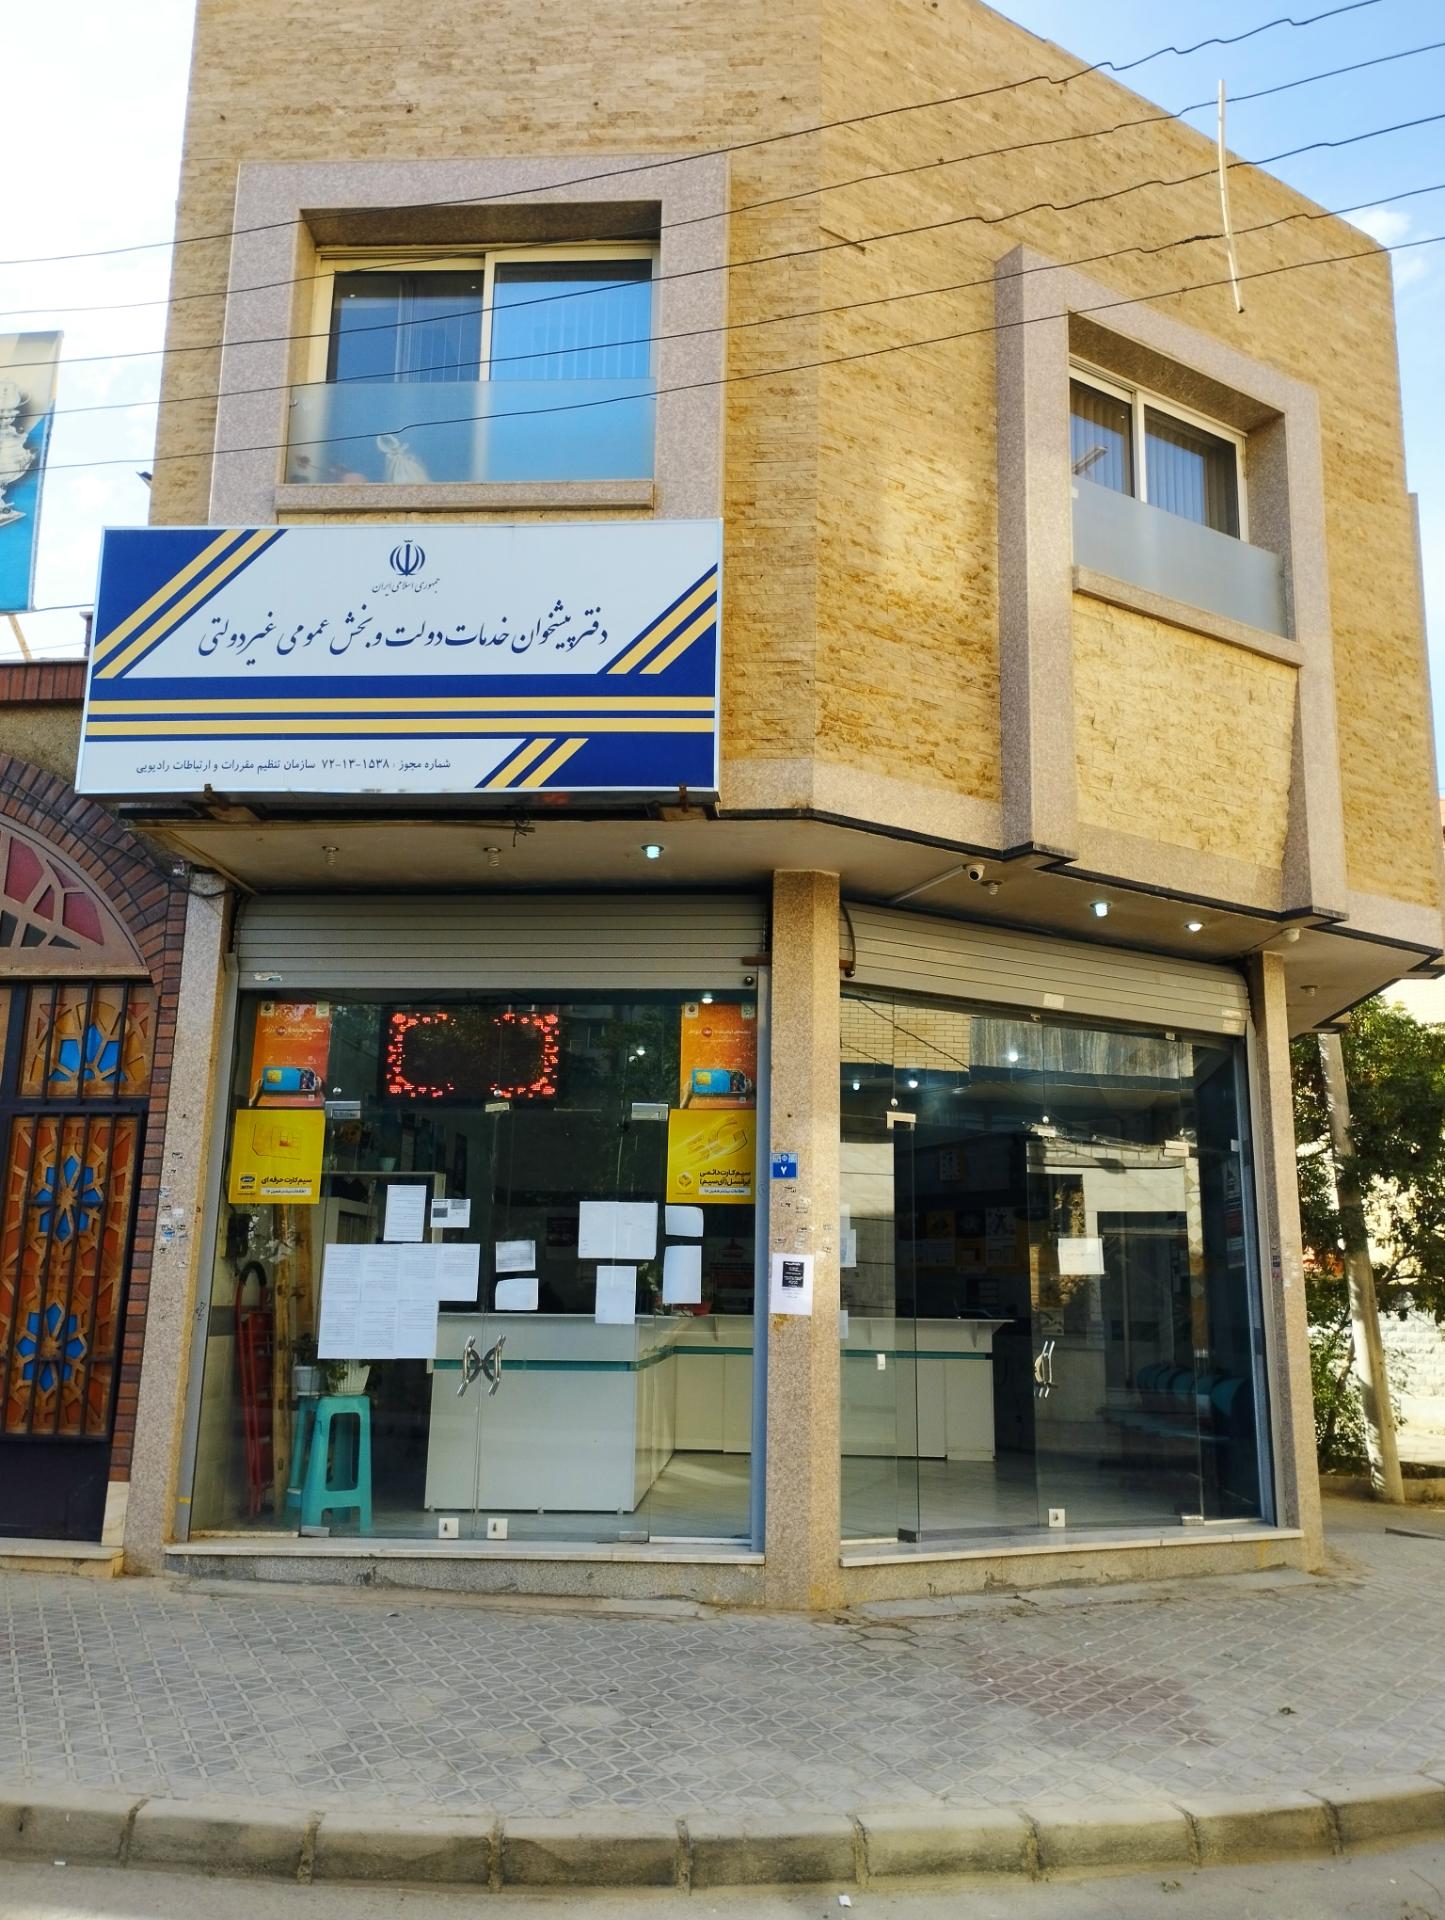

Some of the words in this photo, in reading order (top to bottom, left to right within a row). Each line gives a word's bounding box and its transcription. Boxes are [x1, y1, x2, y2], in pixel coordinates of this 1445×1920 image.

[372, 582, 392, 597] ایران
[391, 581, 414, 593] اسلامی
[414, 578, 440, 594] جمهوری
[329, 603, 374, 656] بخش
[385, 620, 443, 647] دولت
[444, 616, 510, 647] خدمات
[511, 599, 577, 654] پیشخوان
[564, 606, 608, 653] دفتر
[276, 619, 330, 656] عمومی
[135, 759, 170, 774] رادیویی
[172, 759, 211, 773] ارتباطات
[213, 762, 219, 773] و
[221, 759, 255, 772] مقررات
[257, 758, 281, 774] تنظیم
[283, 758, 316, 772] سازمان
[398, 758, 422, 772] مجوز
[424, 757, 451, 771] شماره
